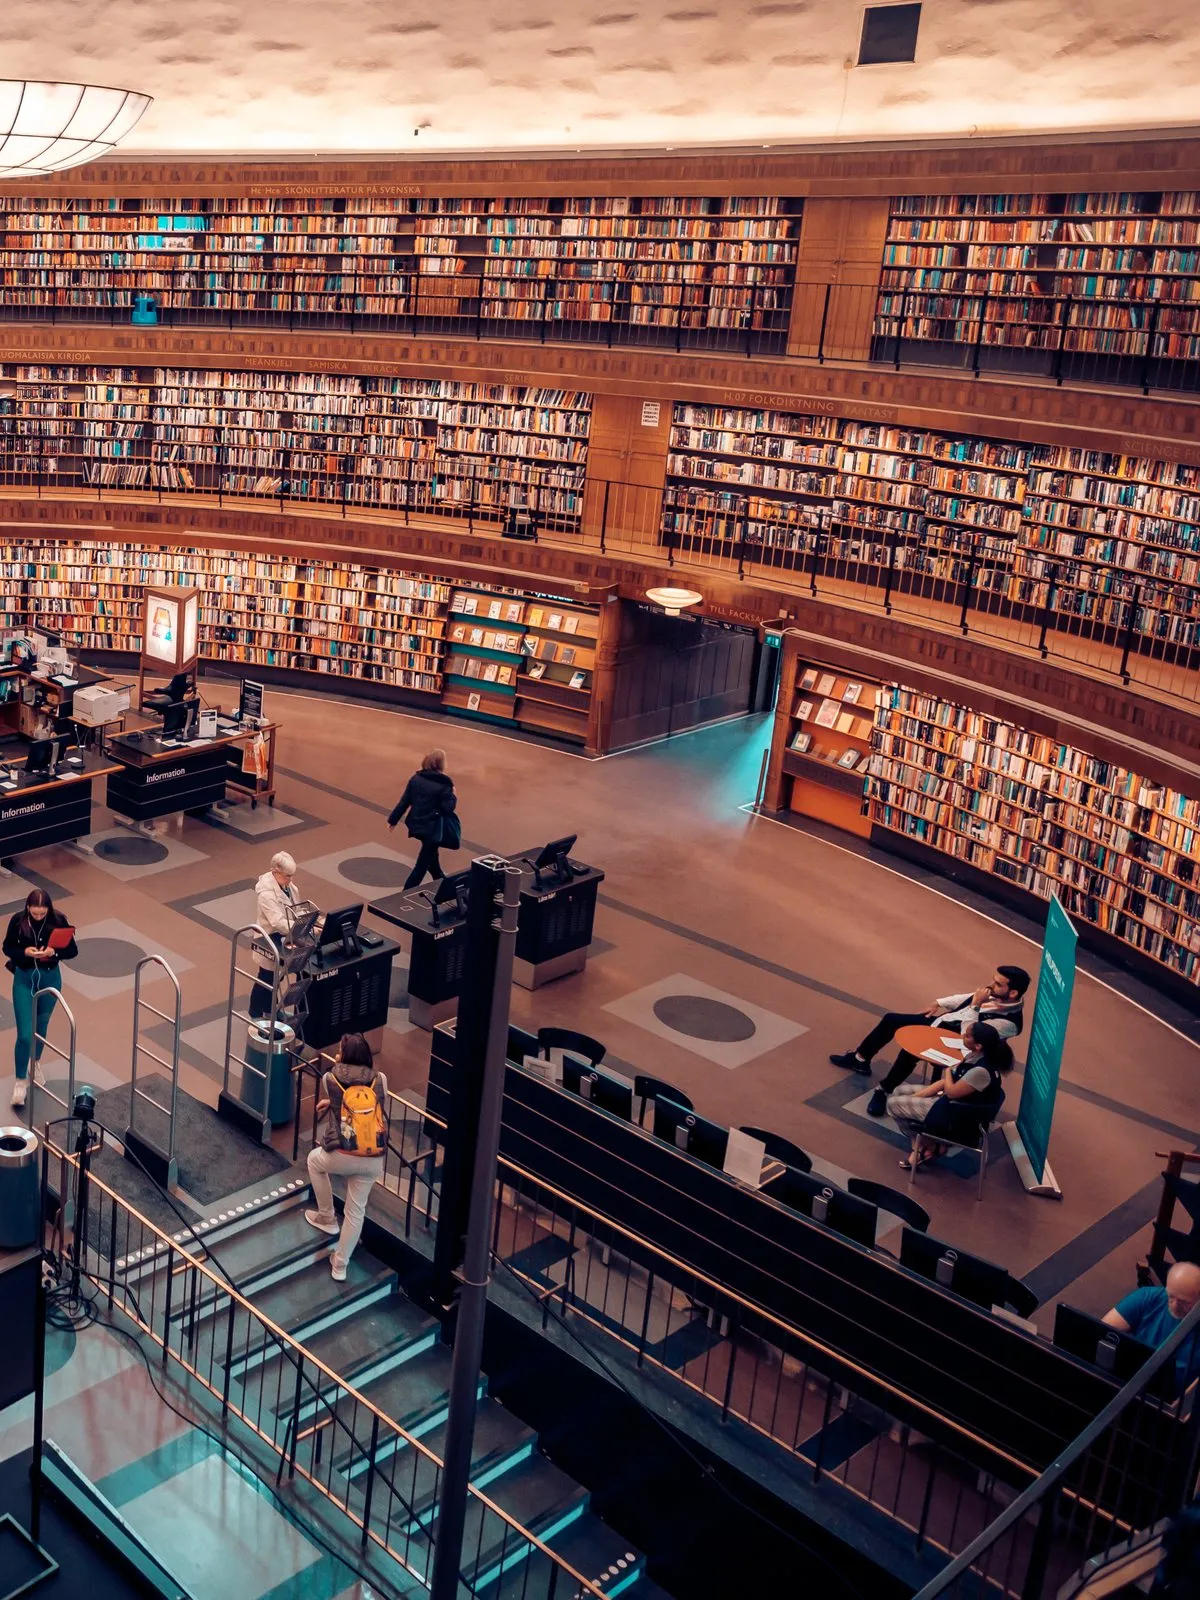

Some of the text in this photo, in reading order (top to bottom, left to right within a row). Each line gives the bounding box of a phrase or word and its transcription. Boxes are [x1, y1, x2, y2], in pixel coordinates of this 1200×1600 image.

[285, 185, 364, 194] SKÖNLITTERATUR
[57, 353, 91, 361] KIRJOJA
[749, 394, 835, 412] FOLKDIKTNING
[710, 604, 727, 615] TILL
[146, 768, 186, 783] Information
[1, 801, 45, 819] Information
